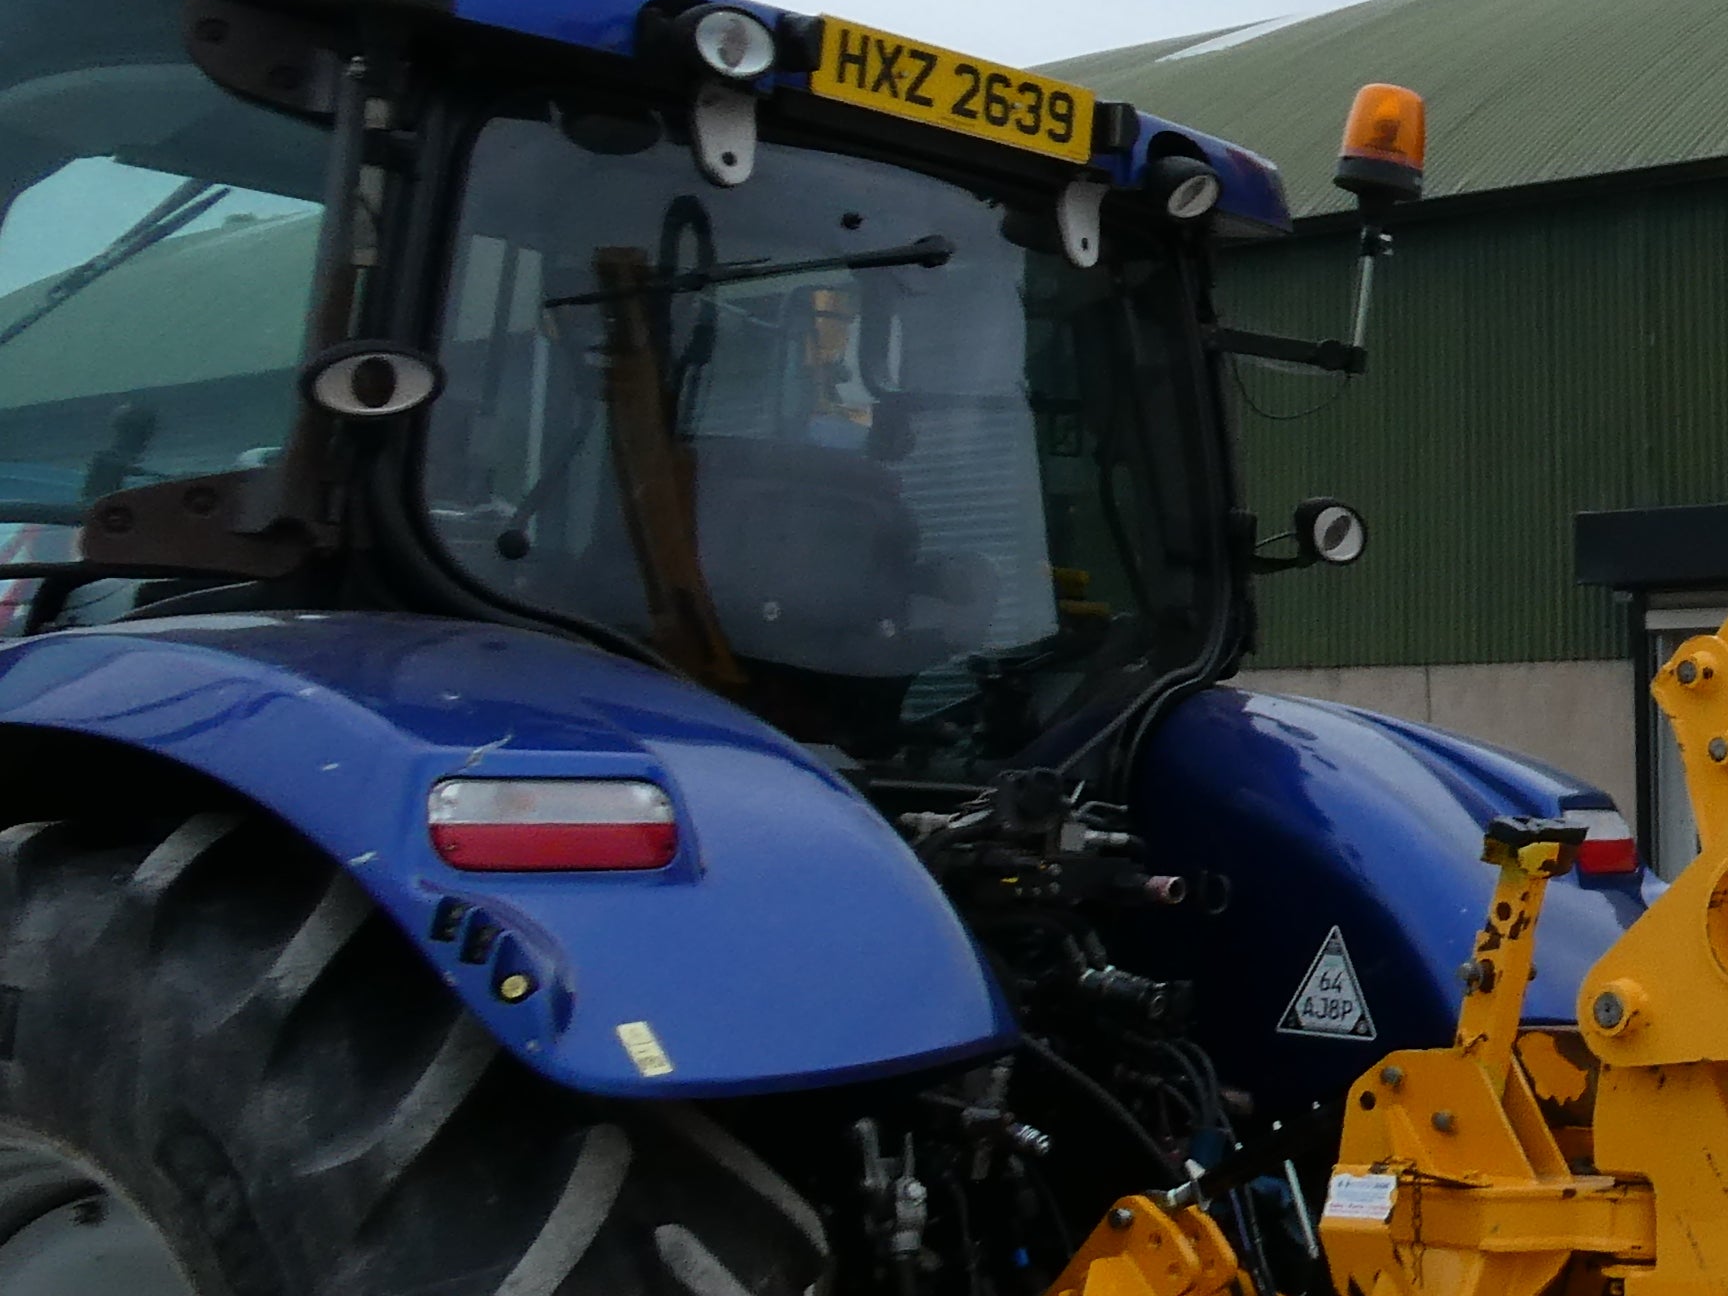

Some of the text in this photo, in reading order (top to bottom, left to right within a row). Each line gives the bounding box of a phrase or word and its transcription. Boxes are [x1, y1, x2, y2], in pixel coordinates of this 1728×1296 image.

[837, 28, 1074, 144] HXZ 2639
[1319, 971, 1343, 993] 64
[1302, 996, 1353, 1021] AJ8P
